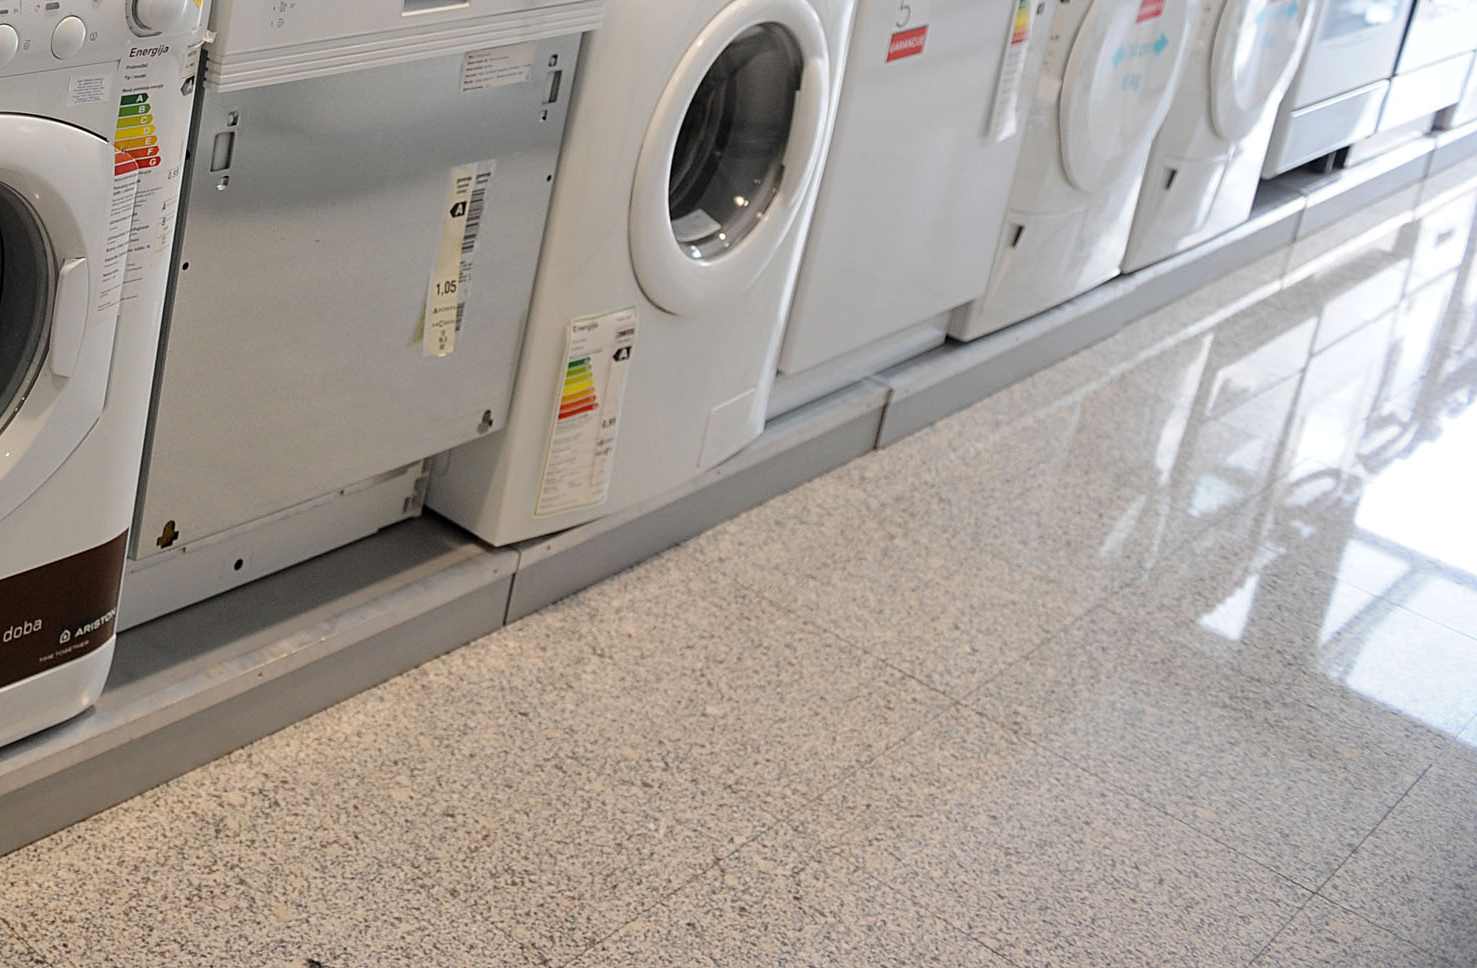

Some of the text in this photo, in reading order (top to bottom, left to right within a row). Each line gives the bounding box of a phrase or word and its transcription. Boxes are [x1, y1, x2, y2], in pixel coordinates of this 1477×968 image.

[129, 44, 170, 58] Energija
[456, 203, 464, 215] A
[2, 618, 43, 644] doba
[75, 608, 116, 638] ARISTON
